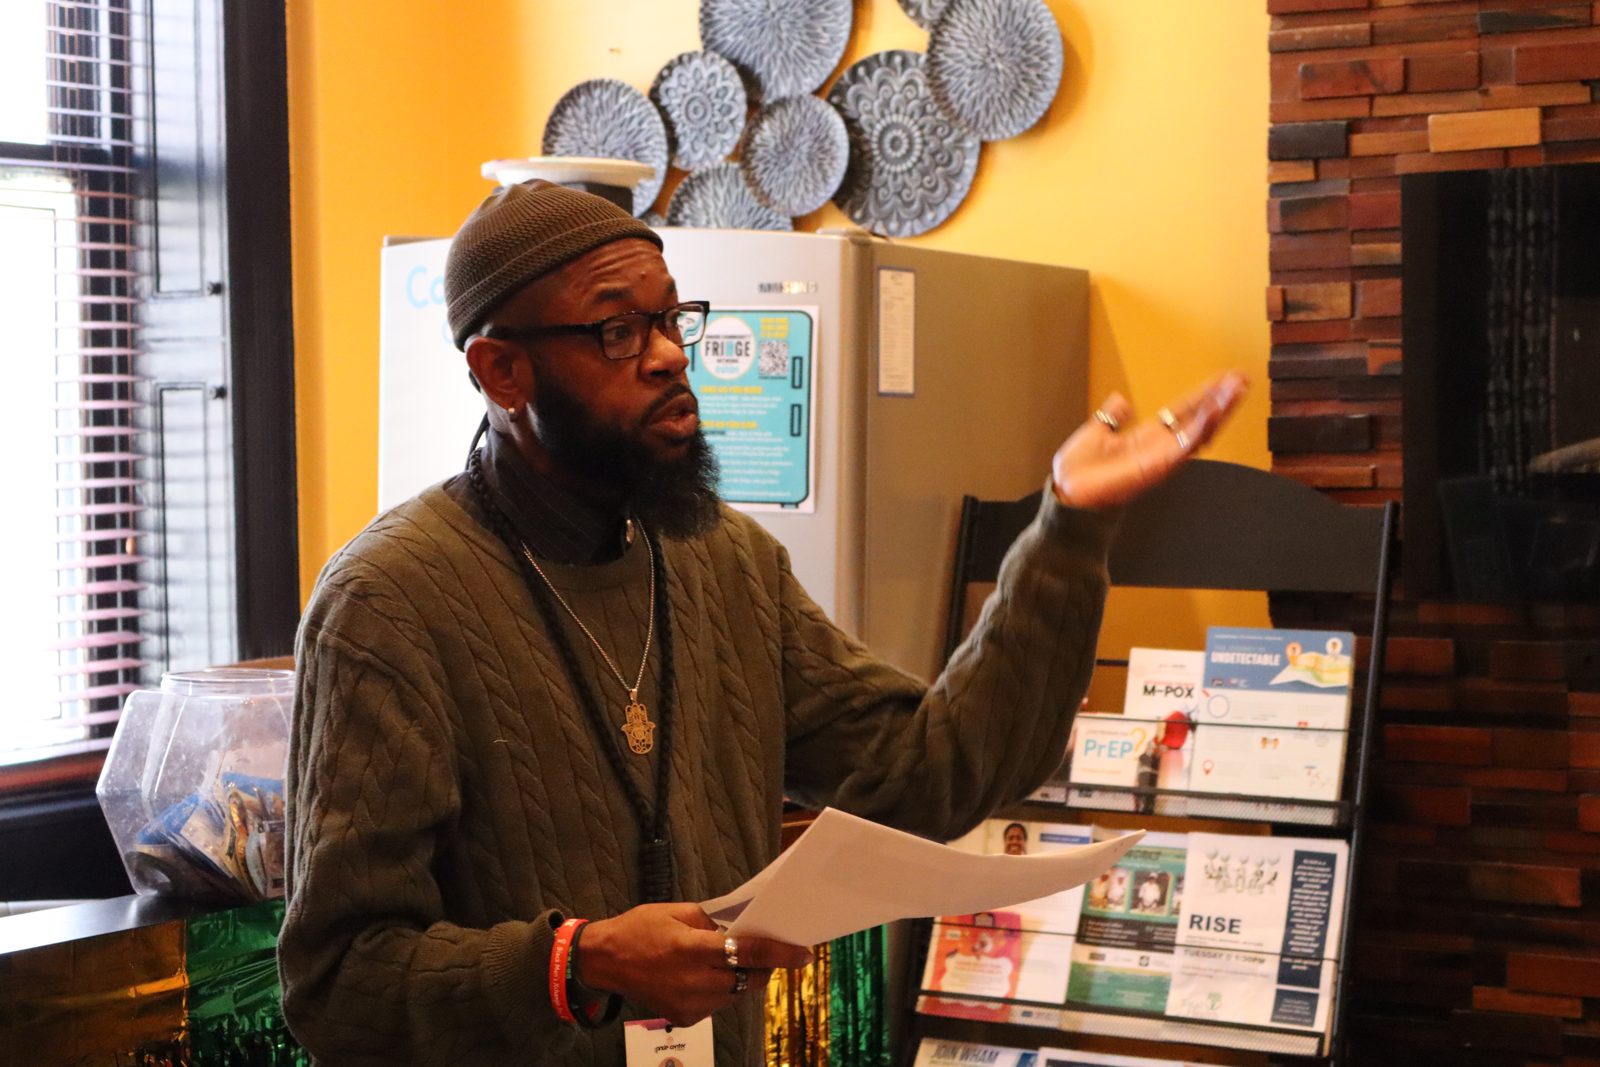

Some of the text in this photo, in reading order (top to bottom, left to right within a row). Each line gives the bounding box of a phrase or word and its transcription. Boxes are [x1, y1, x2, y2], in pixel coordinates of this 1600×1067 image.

[405, 265, 446, 310] Co
[1211, 651, 1281, 667] UNDETECTABLE
[1142, 684, 1194, 698] M-POX
[1189, 914, 1242, 934] RISE
[959, 1047, 1000, 1064] WHAM
